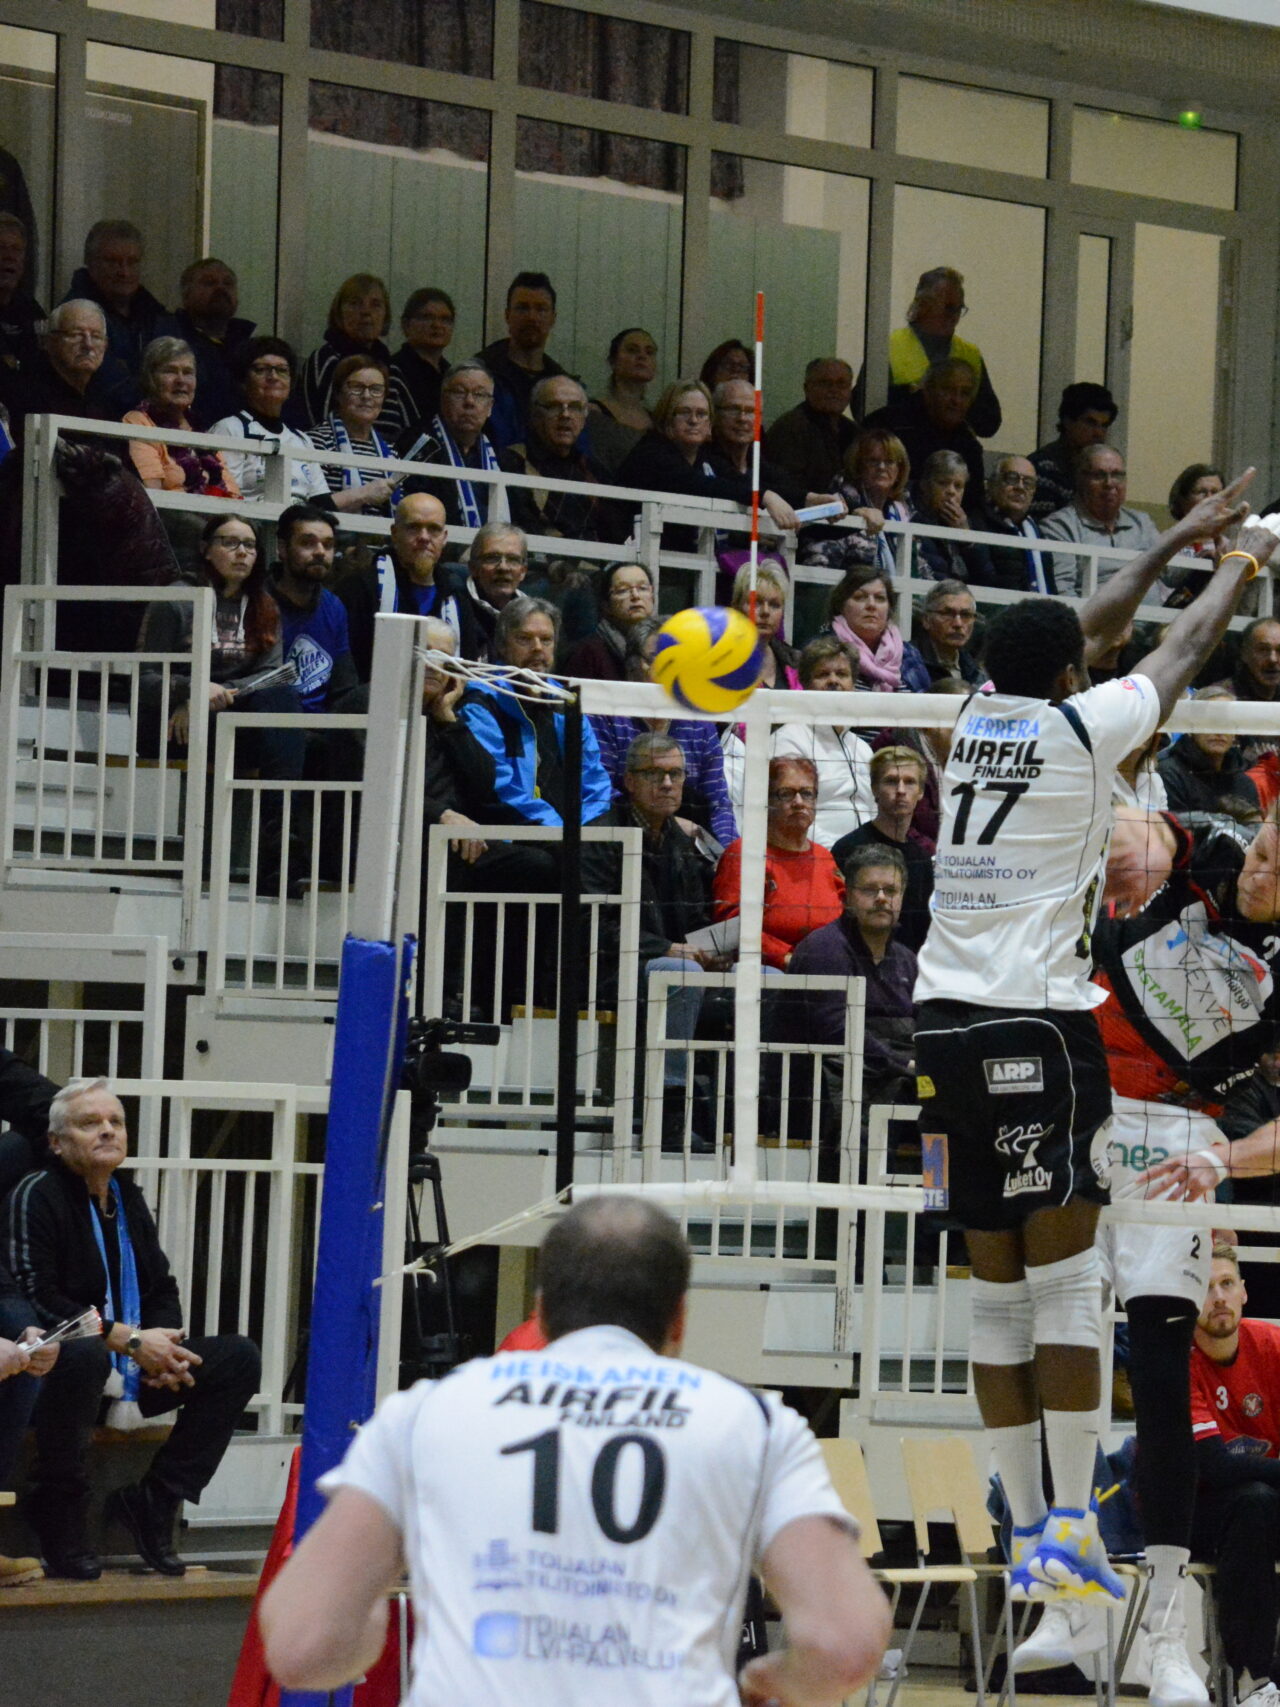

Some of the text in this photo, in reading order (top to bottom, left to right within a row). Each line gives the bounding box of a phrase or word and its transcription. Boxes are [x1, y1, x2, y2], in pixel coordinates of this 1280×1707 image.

[962, 715, 1041, 738] HERRERA
[951, 738, 1045, 766] AIRFIL
[972, 765, 1041, 779] FINLAND
[951, 780, 1030, 845] 17
[944, 856, 996, 867] TOIJALAN
[1016, 868, 1038, 880] OY
[1133, 947, 1204, 1054] SASTAMALA
[1178, 946, 1228, 1034] VEXVE
[992, 1062, 1036, 1081] ARP
[1034, 1165, 1054, 1191] Oy
[1190, 1233, 1201, 1260] 2
[491, 1360, 702, 1389] HEISKANEN
[492, 1380, 692, 1413] AIRFIL
[1215, 1385, 1229, 1411] 3
[558, 1409, 688, 1429] FINLAND
[500, 1426, 668, 1545] 10
